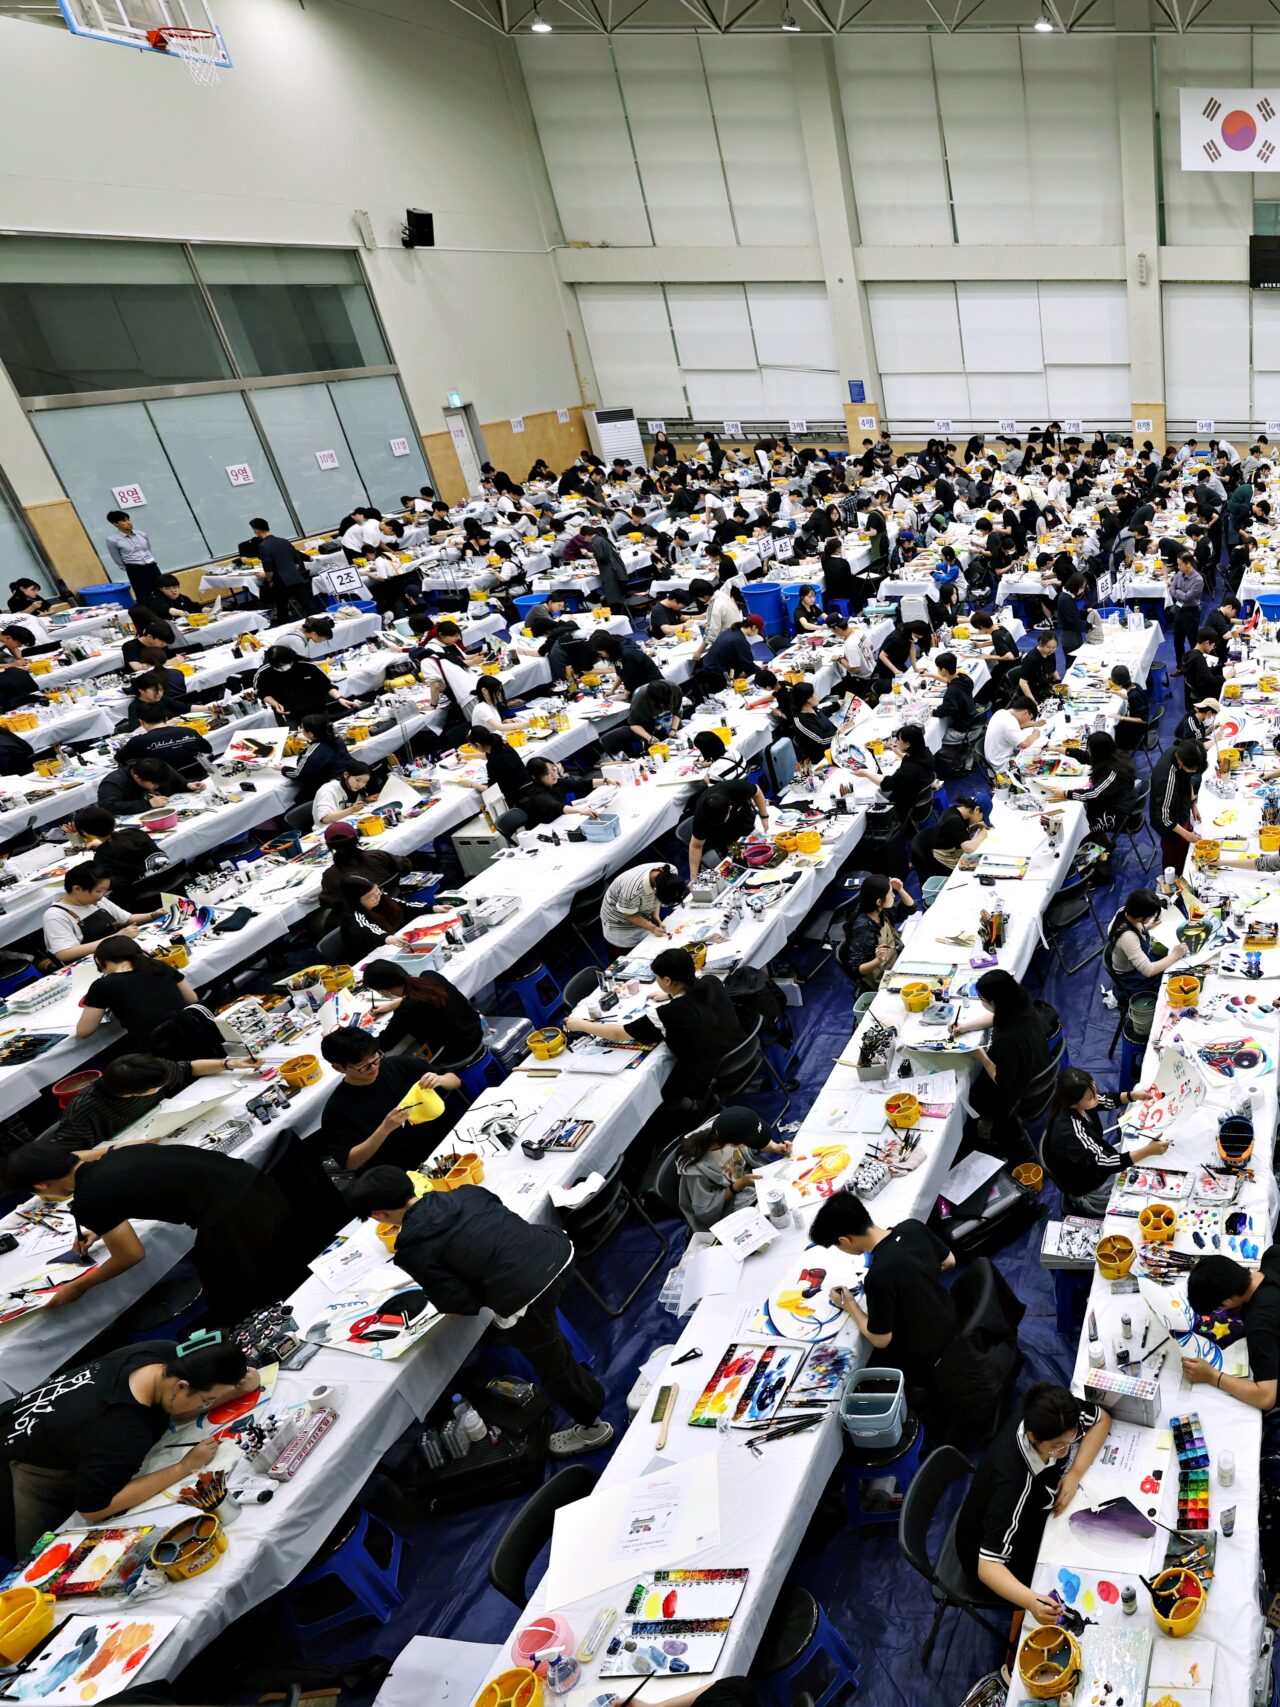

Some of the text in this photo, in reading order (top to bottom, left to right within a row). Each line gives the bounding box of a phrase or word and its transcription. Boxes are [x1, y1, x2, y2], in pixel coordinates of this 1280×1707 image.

[726, 423, 739, 433] 2행
[791, 422, 805, 431] 3행
[860, 419, 874, 428] 4행
[937, 422, 950, 431] 5행
[1001, 423, 1014, 432] 6행
[1066, 422, 1080, 432] 7행
[1136, 421, 1150, 431] 8행
[1198, 422, 1212, 432] 9행
[393, 441, 407, 451] 11열
[319, 452, 336, 463] 10열
[230, 466, 250, 481] 9열
[117, 487, 142, 503] 8열
[762, 540, 771, 552] 3조
[779, 541, 789, 552] 4조
[336, 572, 355, 586] 2조
